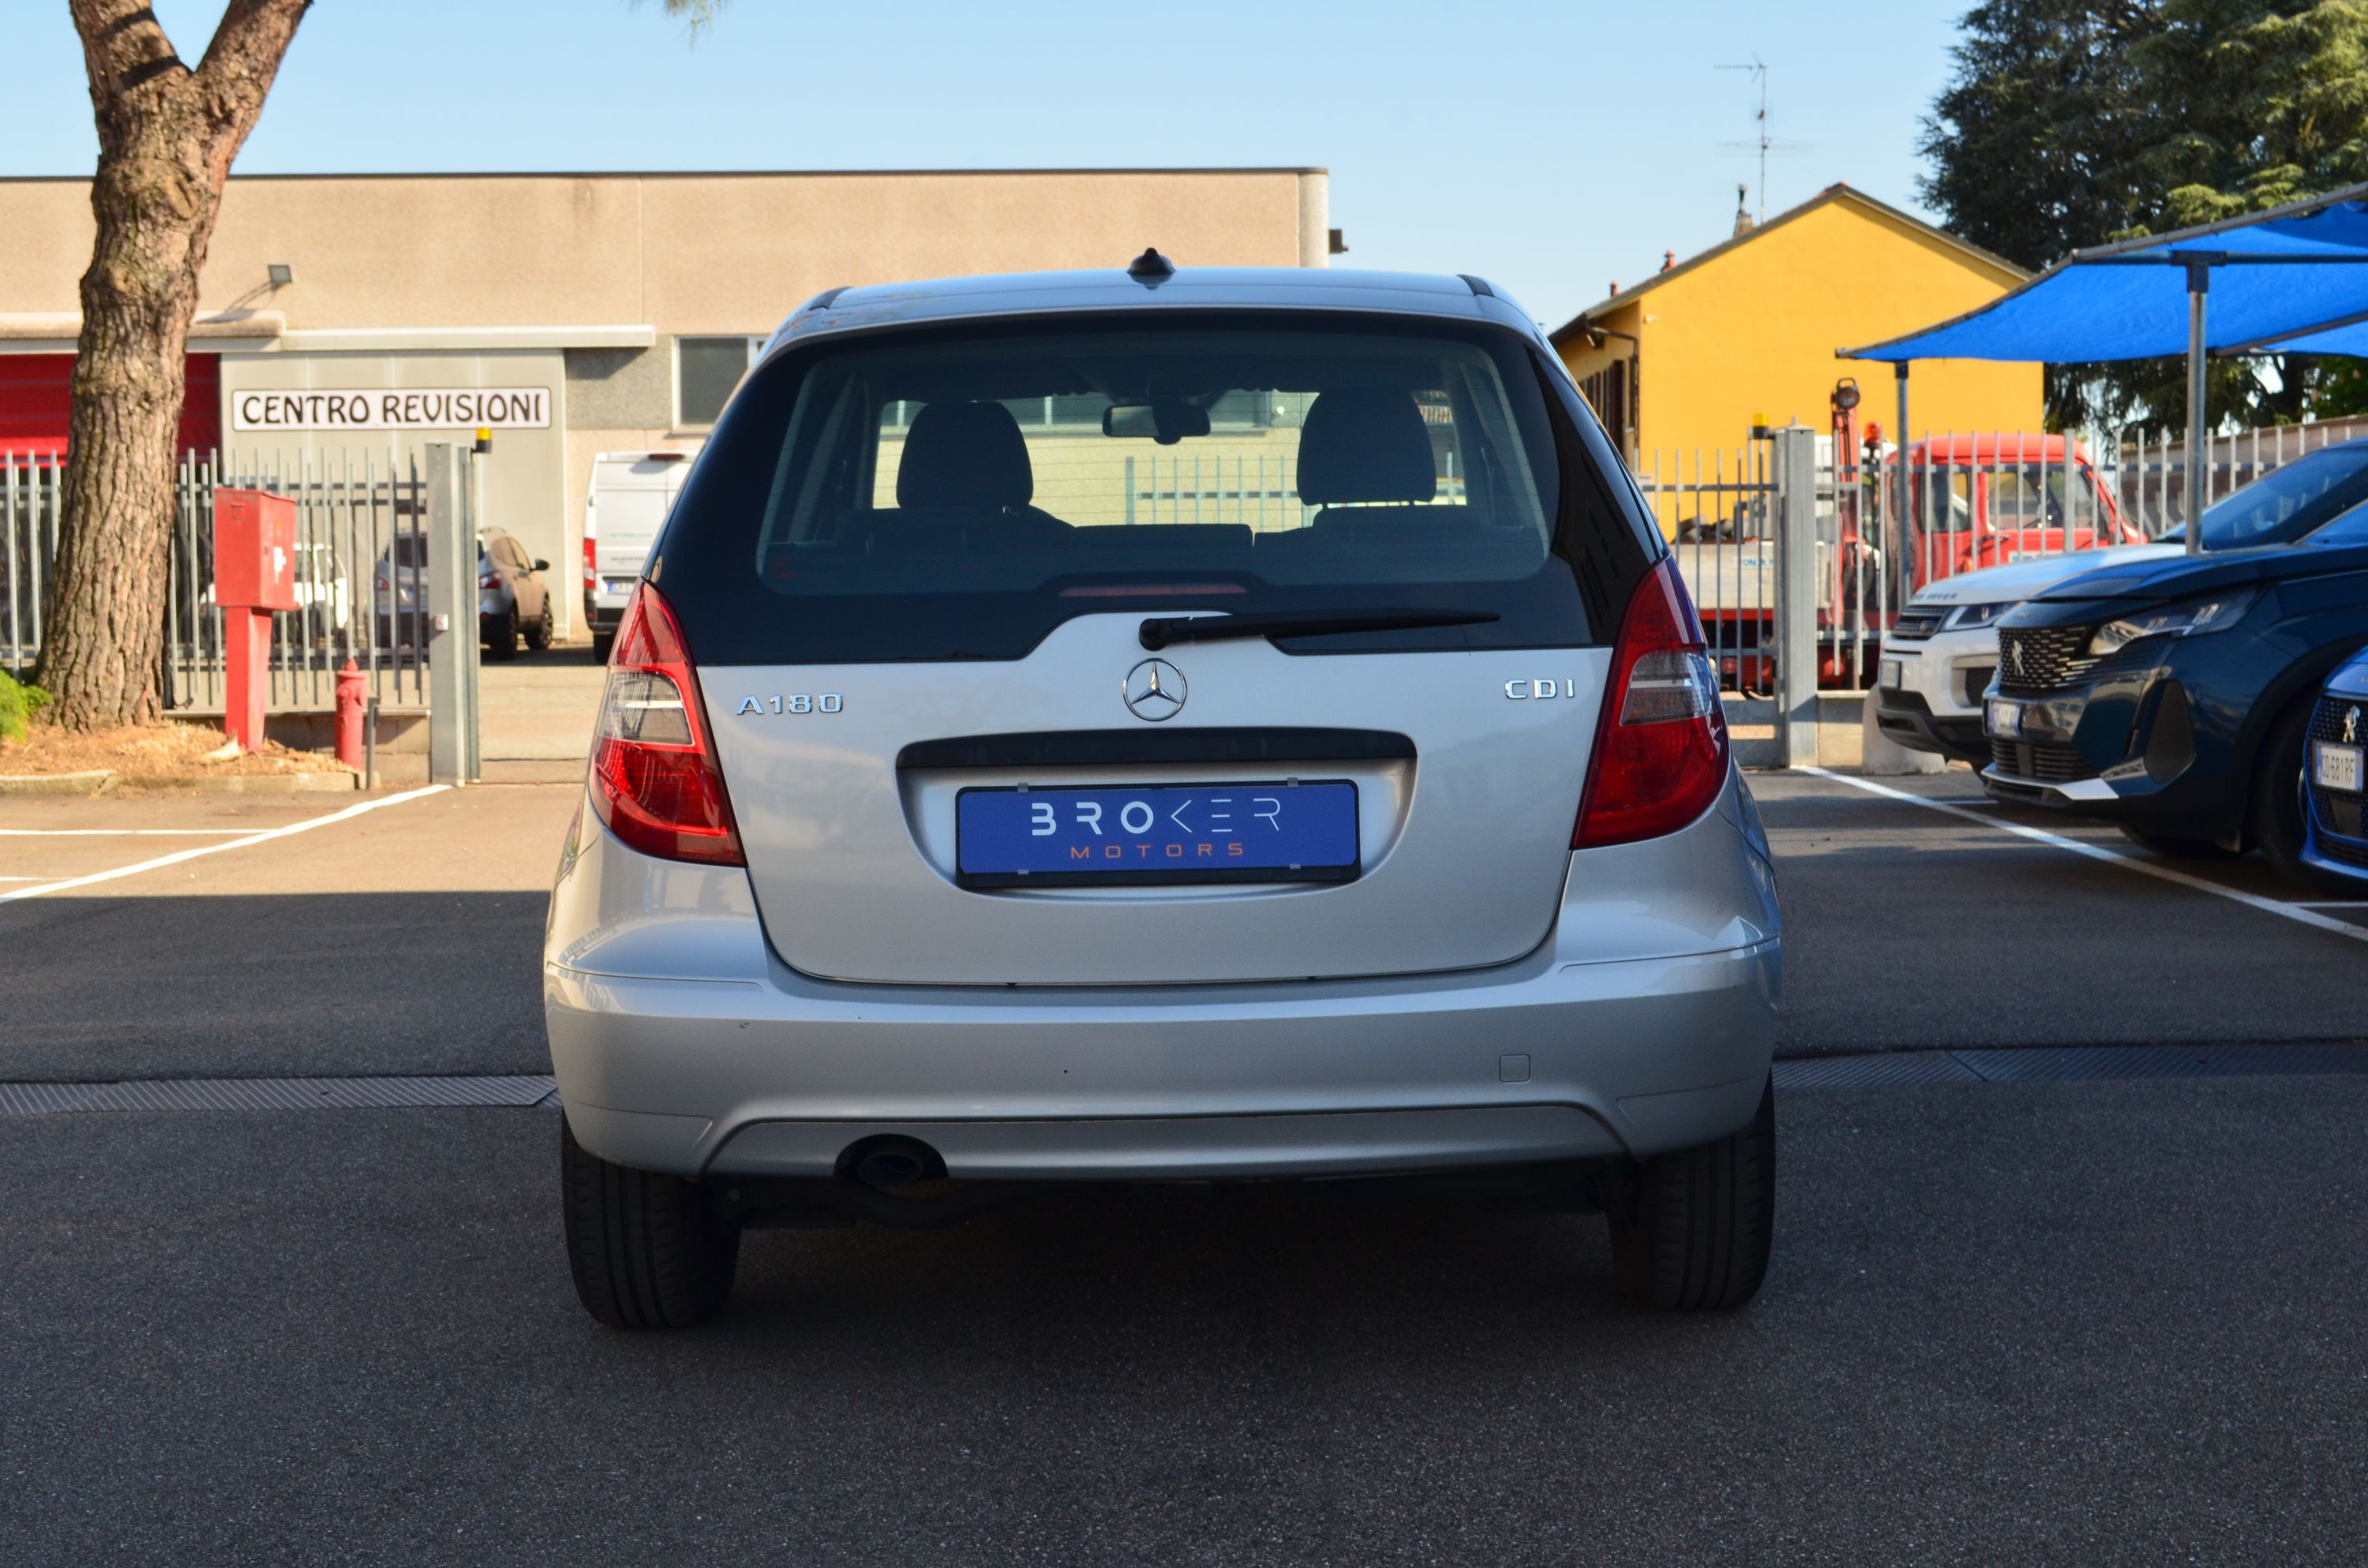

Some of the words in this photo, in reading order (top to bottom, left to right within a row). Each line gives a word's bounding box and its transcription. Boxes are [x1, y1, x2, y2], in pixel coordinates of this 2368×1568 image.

[242, 395, 370, 424] CENTRO
[383, 393, 541, 423] REVISIONI
[1504, 679, 1575, 699] CDI
[736, 693, 844, 715] A180
[1032, 797, 1281, 836] BROKER
[1070, 842, 1244, 859] MOTORS
